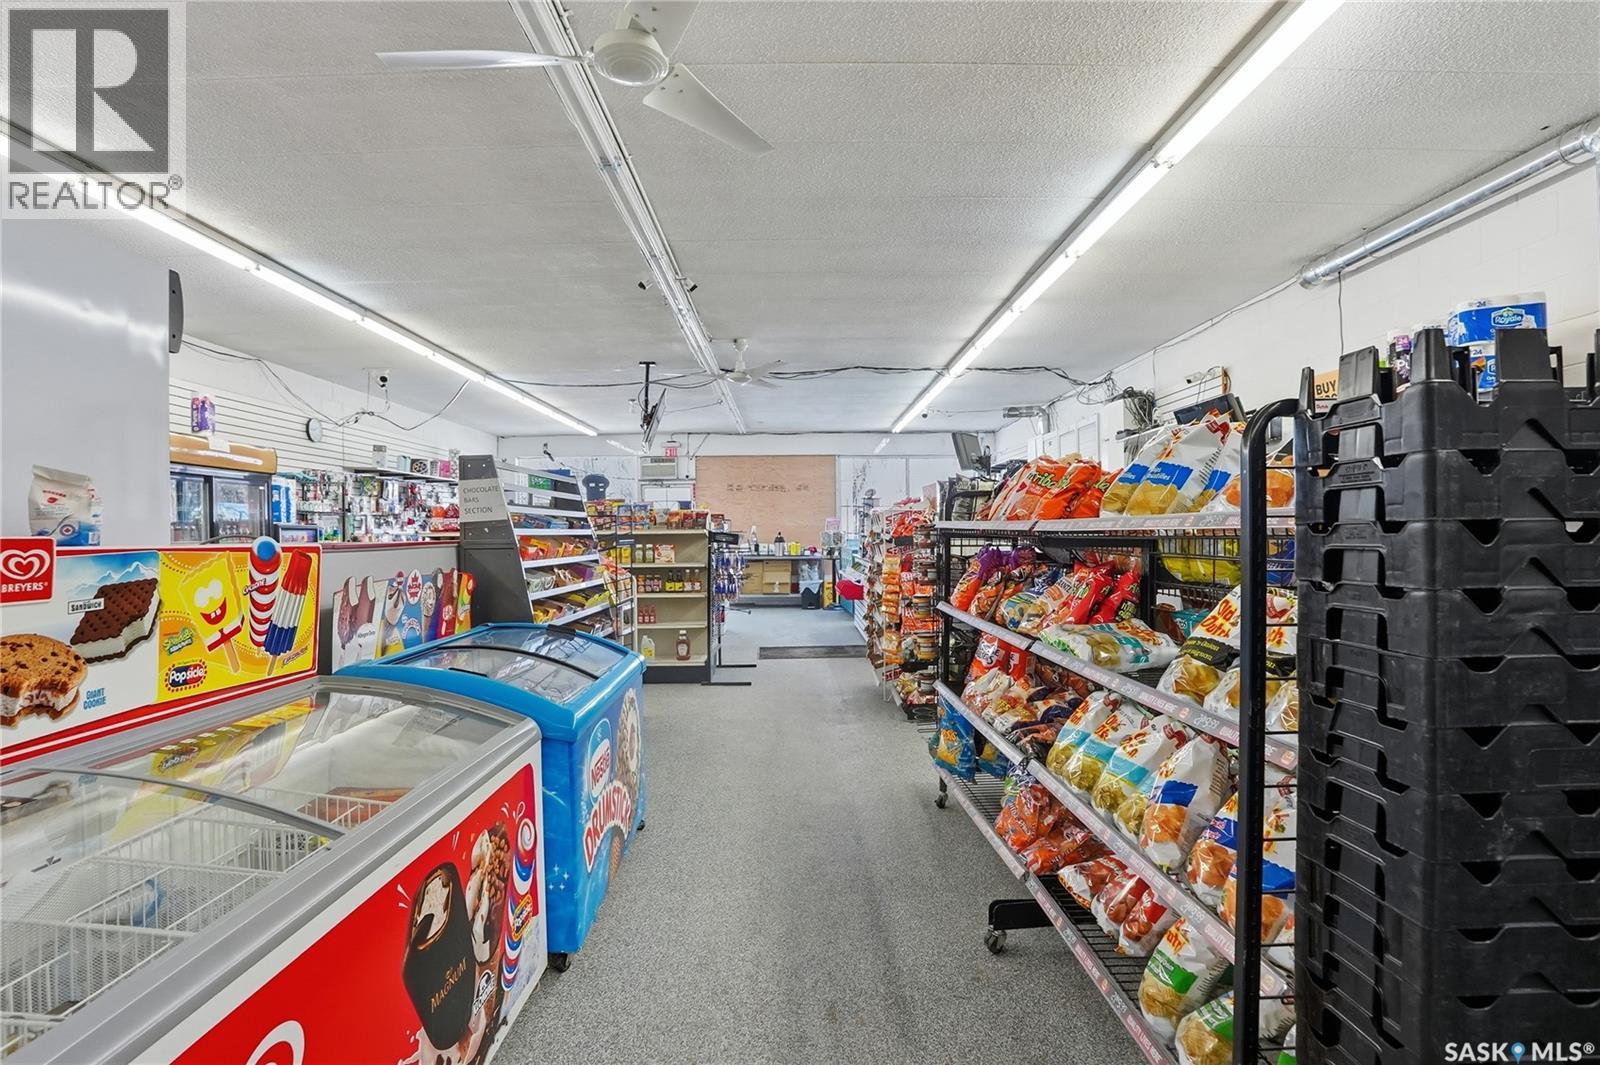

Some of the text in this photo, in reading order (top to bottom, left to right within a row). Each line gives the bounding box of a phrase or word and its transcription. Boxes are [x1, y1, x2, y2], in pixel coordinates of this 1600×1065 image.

[1494, 314, 1522, 325] Royale
[1315, 379, 1337, 396] BUY
[463, 486, 500, 495] CHOCOLATE
[464, 507, 494, 515] SECTION
[1, 582, 44, 593] BREYERS
[71, 601, 102, 612] SANDWICH
[168, 665, 205, 684] Popsicle
[430, 957, 467, 1014] MAGNUM
